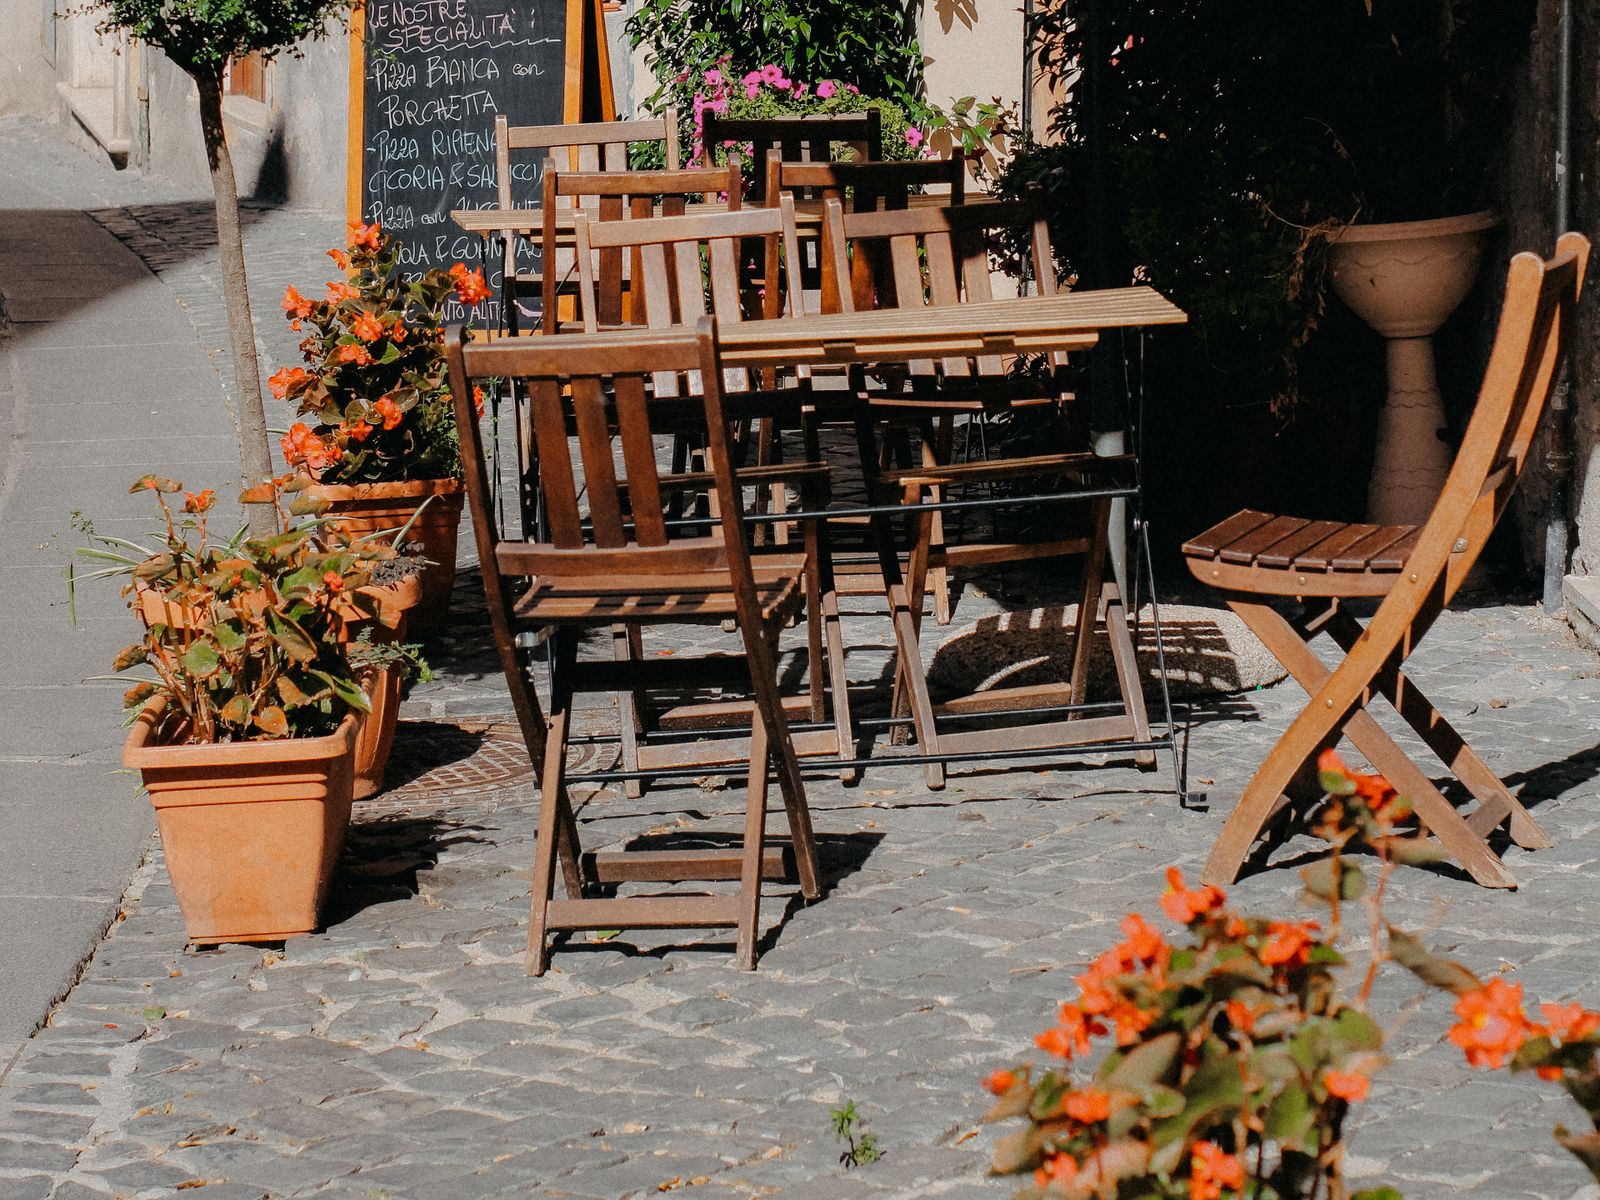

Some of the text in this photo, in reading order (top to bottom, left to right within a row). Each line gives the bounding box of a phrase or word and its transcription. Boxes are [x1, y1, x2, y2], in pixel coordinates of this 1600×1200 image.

[368, 0, 467, 29] LE NOSTRE
[426, 55, 500, 89] BIANCA
[377, 90, 499, 130] PORCHETTA
[369, 164, 446, 195] CICORIA
